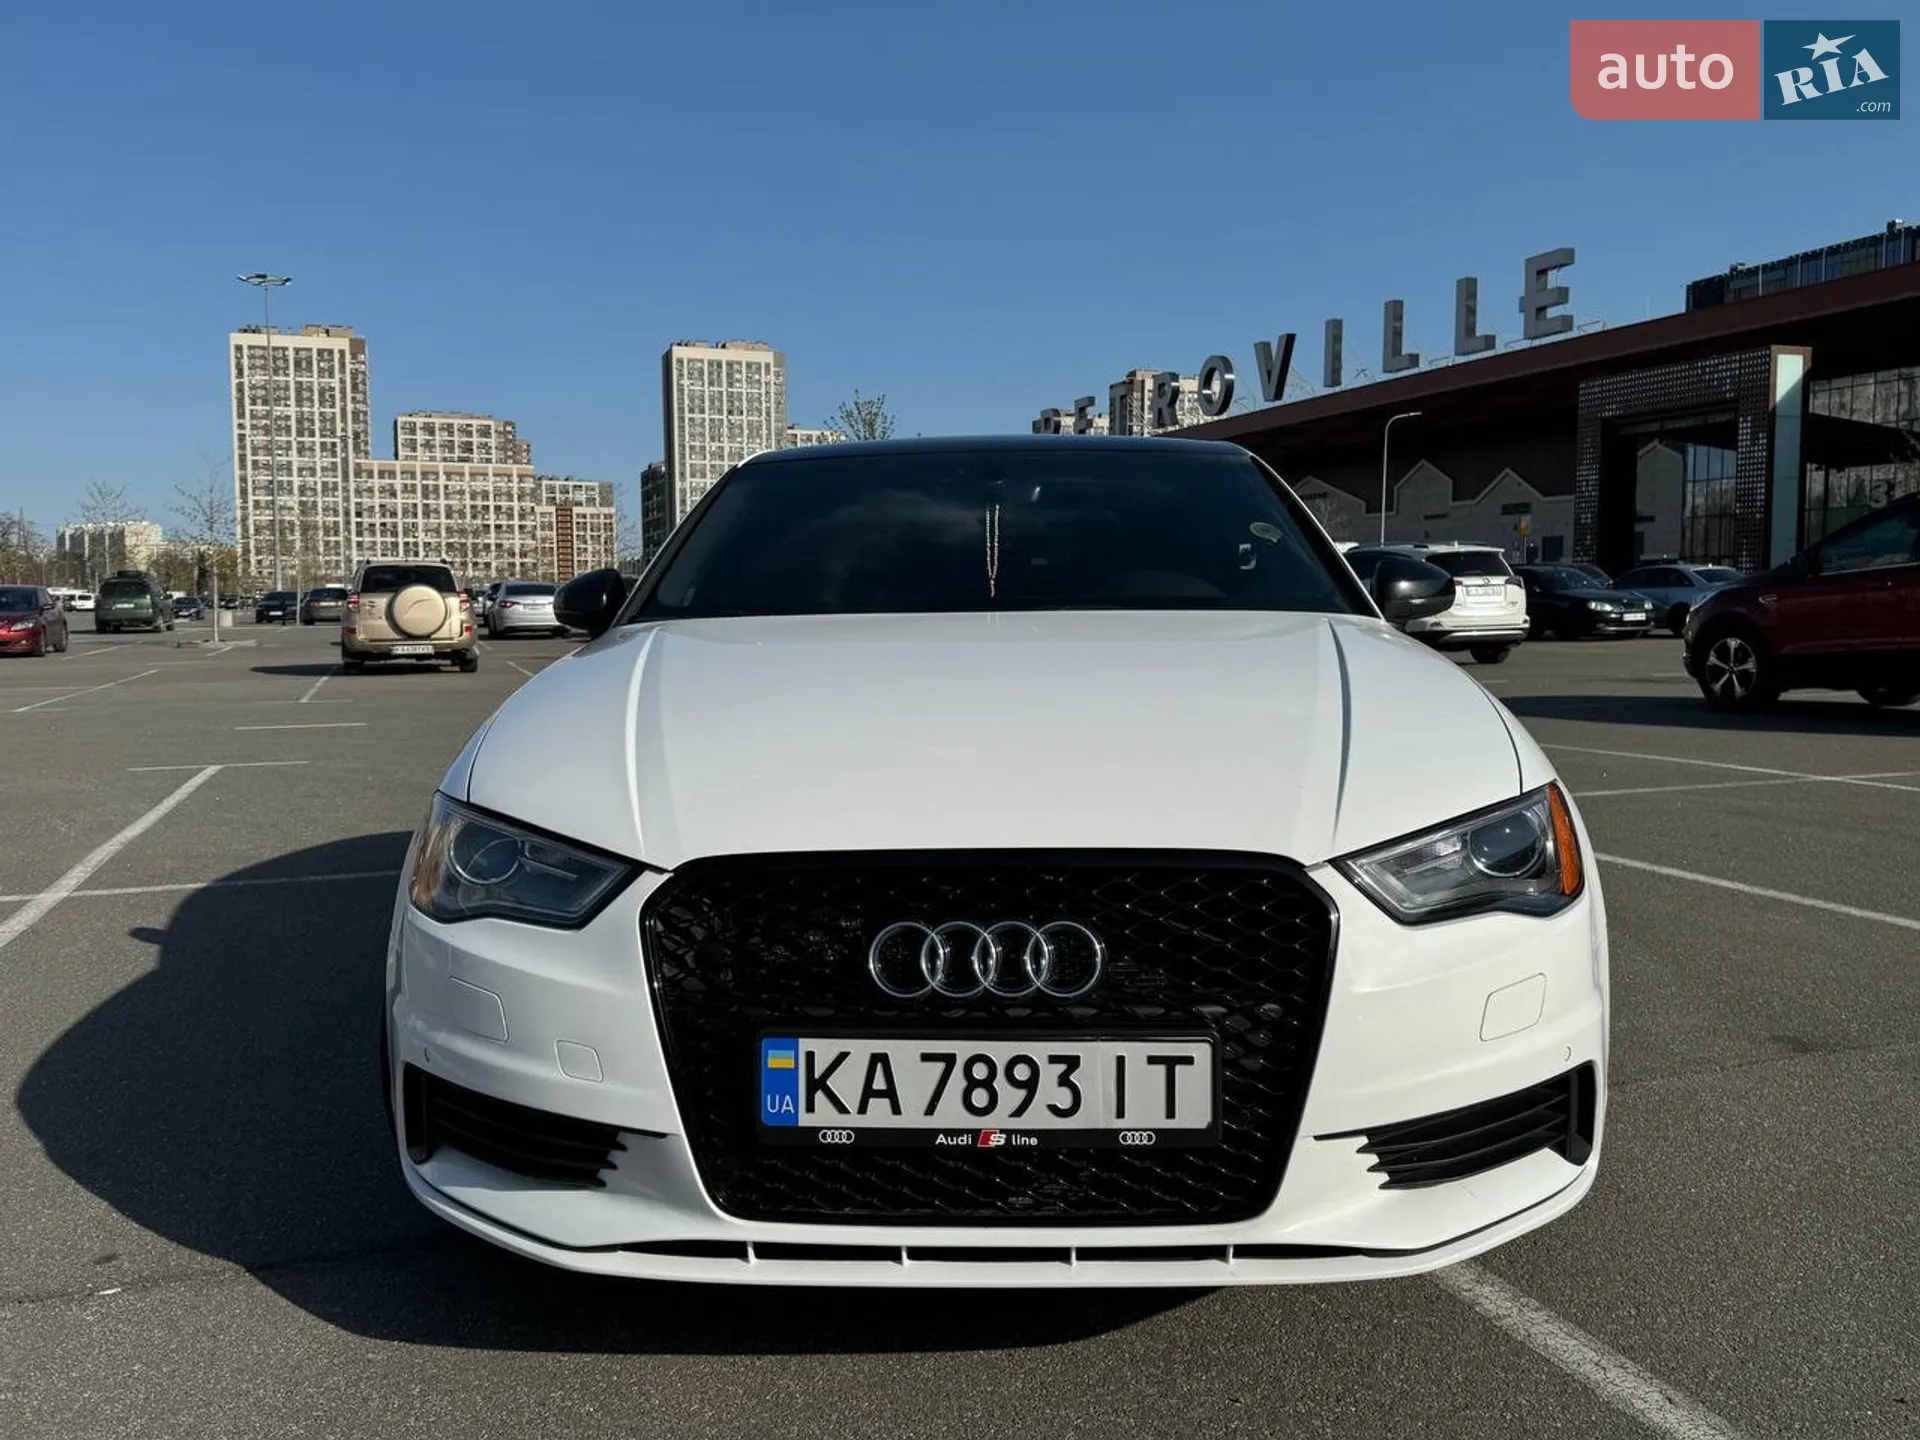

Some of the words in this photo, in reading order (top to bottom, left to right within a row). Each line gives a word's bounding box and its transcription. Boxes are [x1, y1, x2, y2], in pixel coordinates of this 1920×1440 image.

[804, 1050, 902, 1116] KA
[919, 1052, 1083, 1119] 7893
[1115, 1054, 1196, 1120] IT
[766, 1094, 795, 1115] UA
[935, 1133, 973, 1146] Audi
[1012, 1133, 1039, 1146] line
